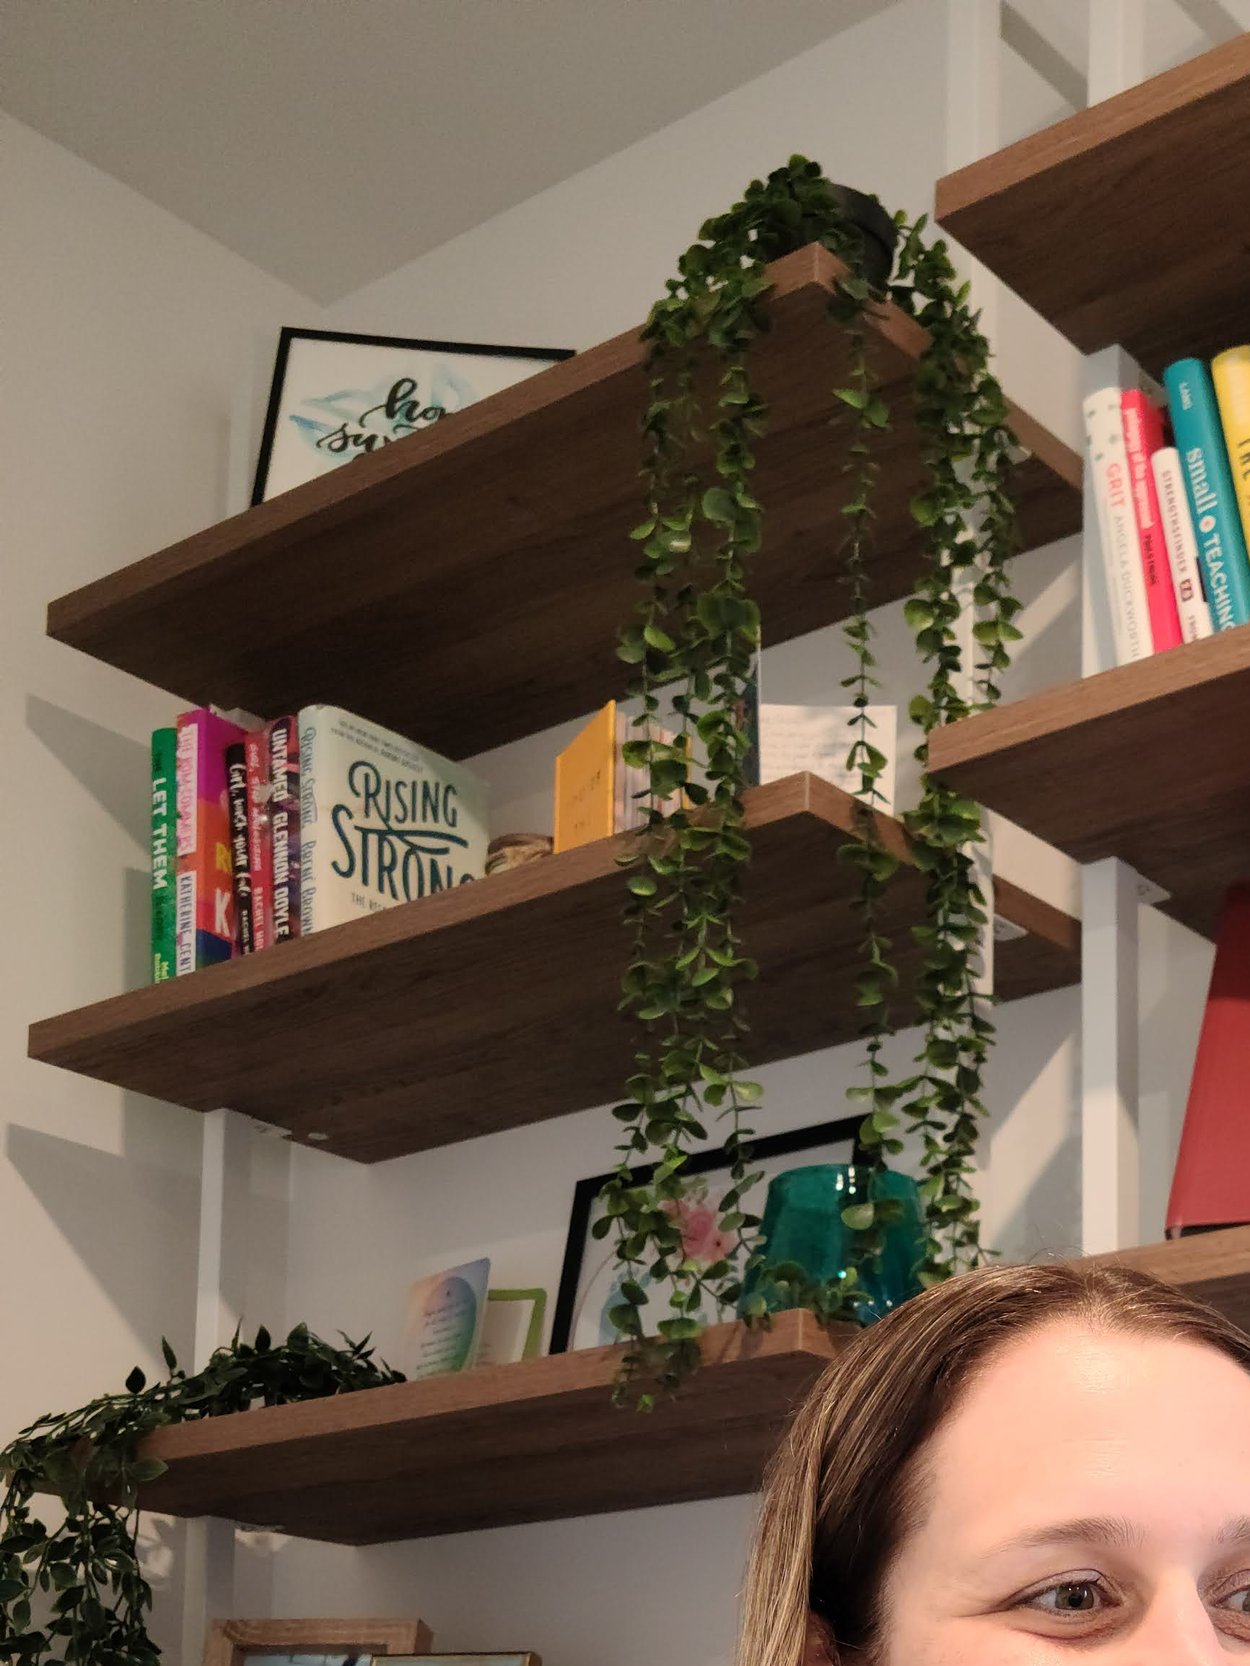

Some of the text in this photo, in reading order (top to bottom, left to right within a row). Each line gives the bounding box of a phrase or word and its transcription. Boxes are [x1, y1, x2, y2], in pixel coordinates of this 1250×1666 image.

[1105, 462, 1126, 508] GRIT
[1186, 447, 1218, 515] small
[152, 776, 168, 817] LET
[348, 760, 458, 830] RISING
[152, 822, 169, 891] THEM
[272, 727, 290, 938] UNTAMED GLENNON DOYLE
[180, 875, 192, 936] KATHERINE
